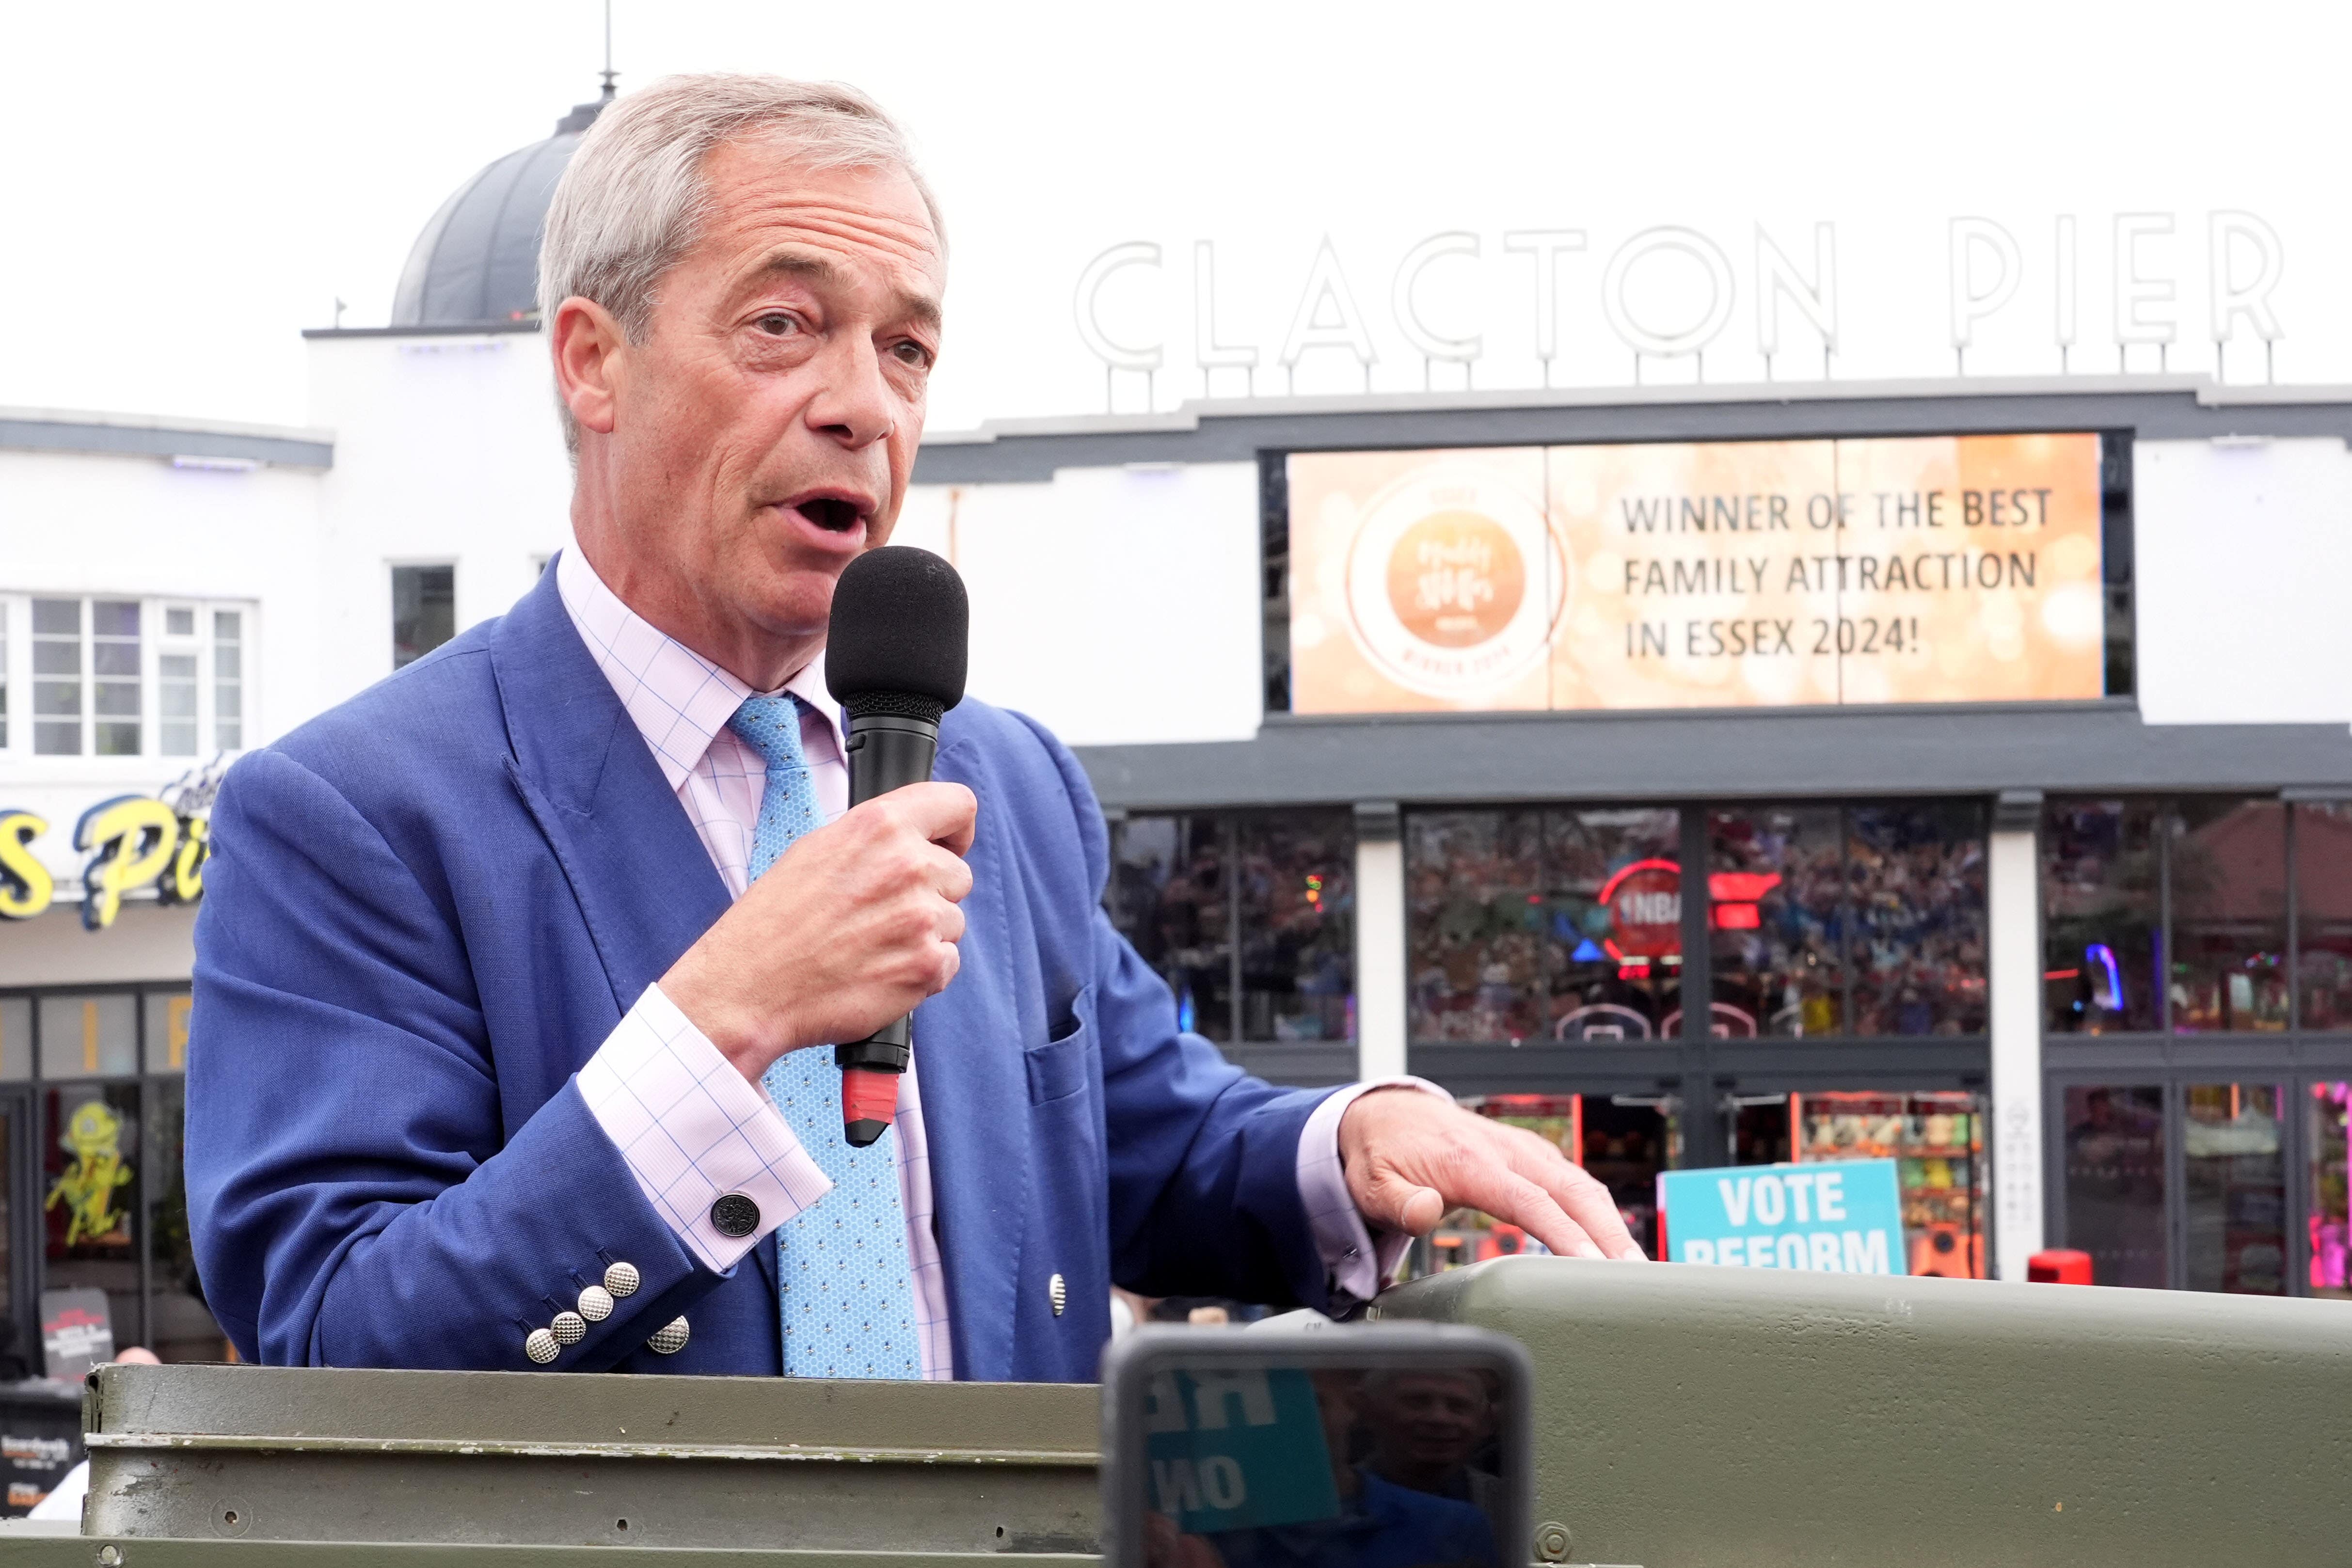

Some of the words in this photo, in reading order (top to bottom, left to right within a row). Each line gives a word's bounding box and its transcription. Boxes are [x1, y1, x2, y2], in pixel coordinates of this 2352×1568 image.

[1073, 219, 1839, 371] CLACTON
[1948, 209, 2286, 348] PIER
[1622, 493, 1790, 534] WINNER
[1807, 492, 1856, 529] OF
[1874, 491, 1945, 528] THE
[1962, 489, 2053, 527] BEST
[1624, 557, 1769, 595] FAMILY
[1786, 552, 2036, 593] ATTRACTION
[1626, 621, 1668, 658] IN
[1687, 618, 1795, 656] ESSEX
[1812, 616, 1919, 654] 2024!
[78, 796, 212, 928] Pi
[1717, 1172, 1847, 1227] VOTE
